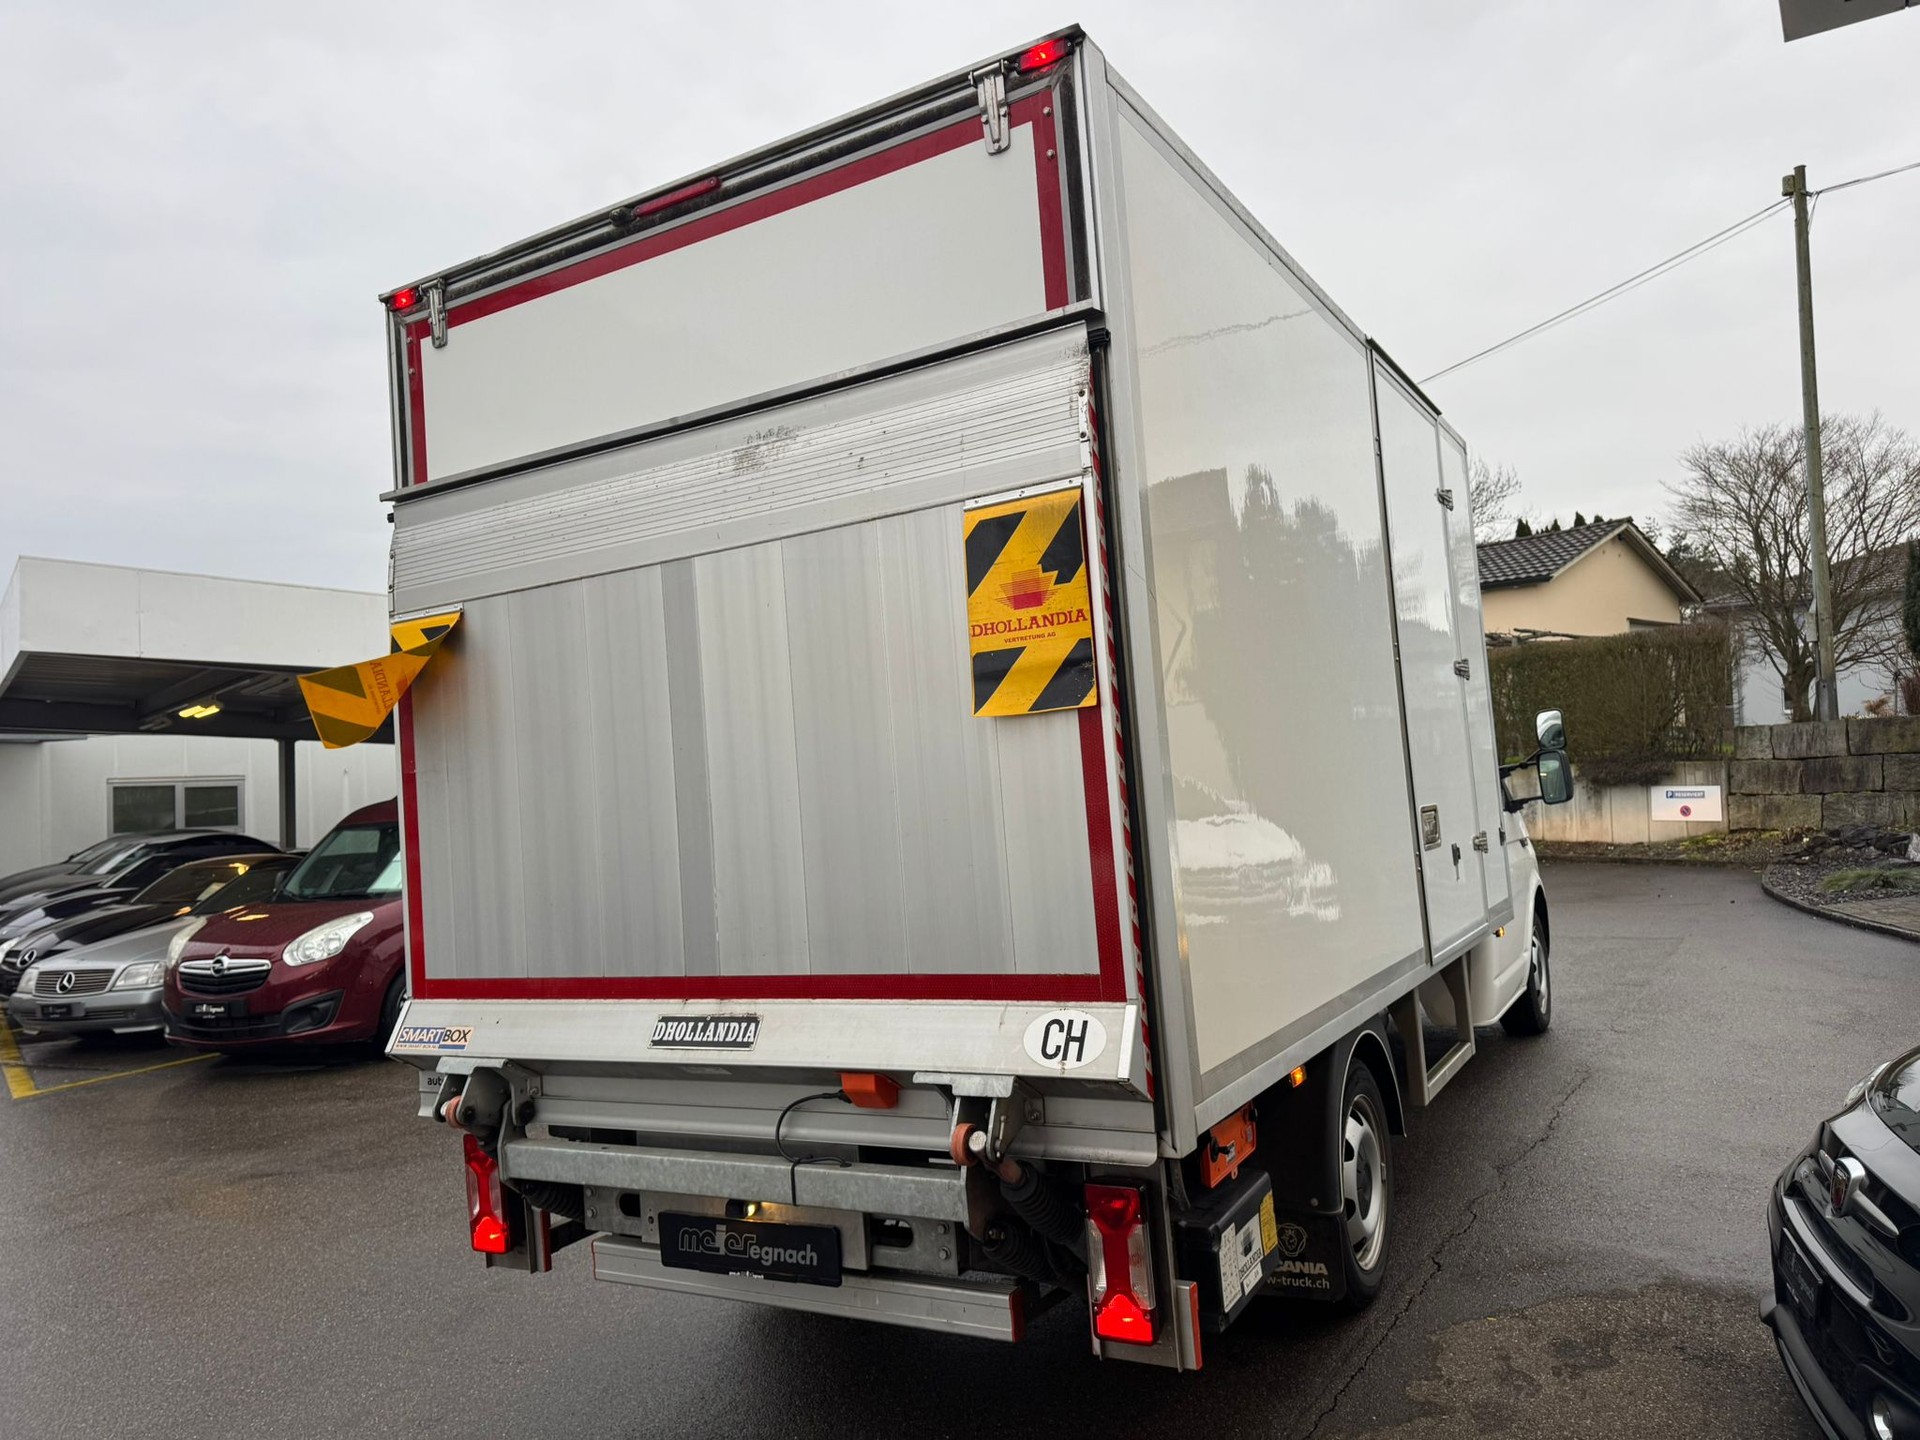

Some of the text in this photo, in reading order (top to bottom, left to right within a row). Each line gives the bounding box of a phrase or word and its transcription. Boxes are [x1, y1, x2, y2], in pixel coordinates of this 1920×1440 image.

[971, 608, 1088, 637] DHOLLANDIA
[1004, 633, 1046, 644] VERTRETUNG
[652, 1021, 757, 1042] DHOLLANDIA
[1041, 1018, 1088, 1062] CH
[427, 1076, 444, 1086] aut
[750, 1244, 818, 1266] egnach
